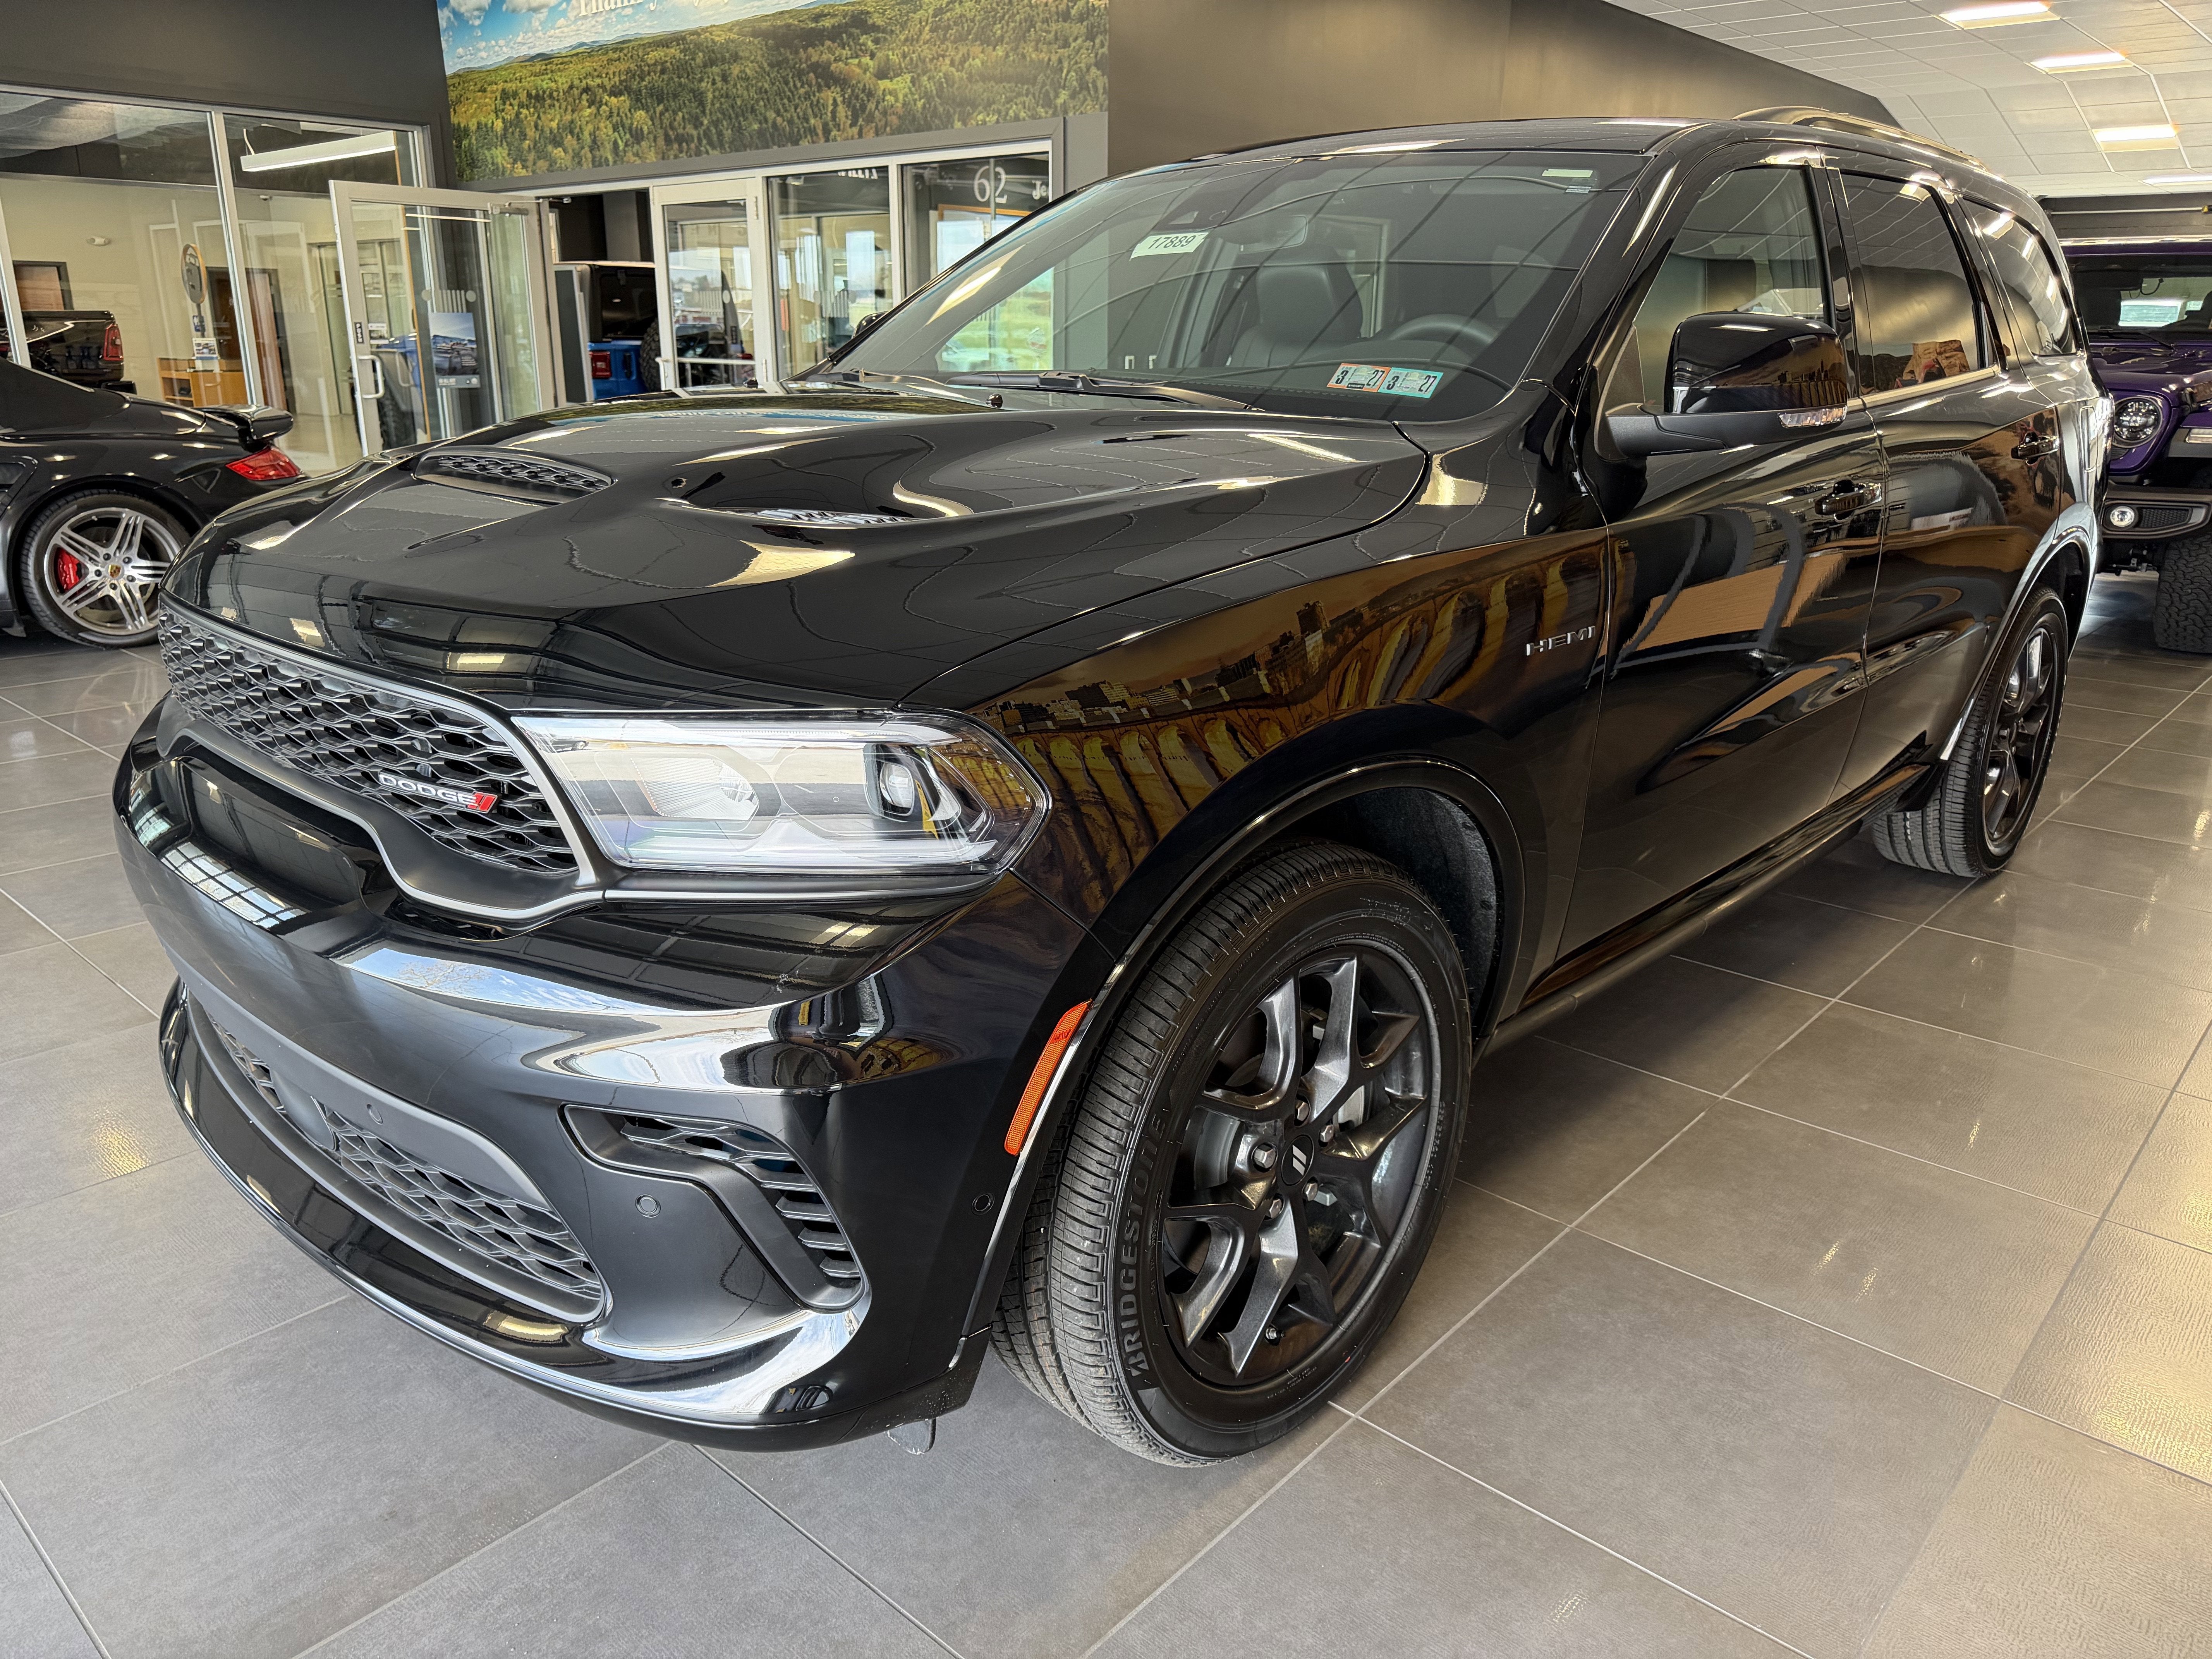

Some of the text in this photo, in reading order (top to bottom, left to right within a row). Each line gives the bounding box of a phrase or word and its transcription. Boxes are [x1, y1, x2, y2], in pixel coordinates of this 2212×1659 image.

[974, 165, 1008, 204] 62
[1148, 235, 1197, 249] 17889
[1334, 369, 1385, 387] 3 27
[1386, 374, 1437, 393] 3 27
[1526, 625, 1595, 656] HEMI
[378, 774, 479, 806] DODGE
[1119, 1111, 1165, 1377] BRIDGESTONE
